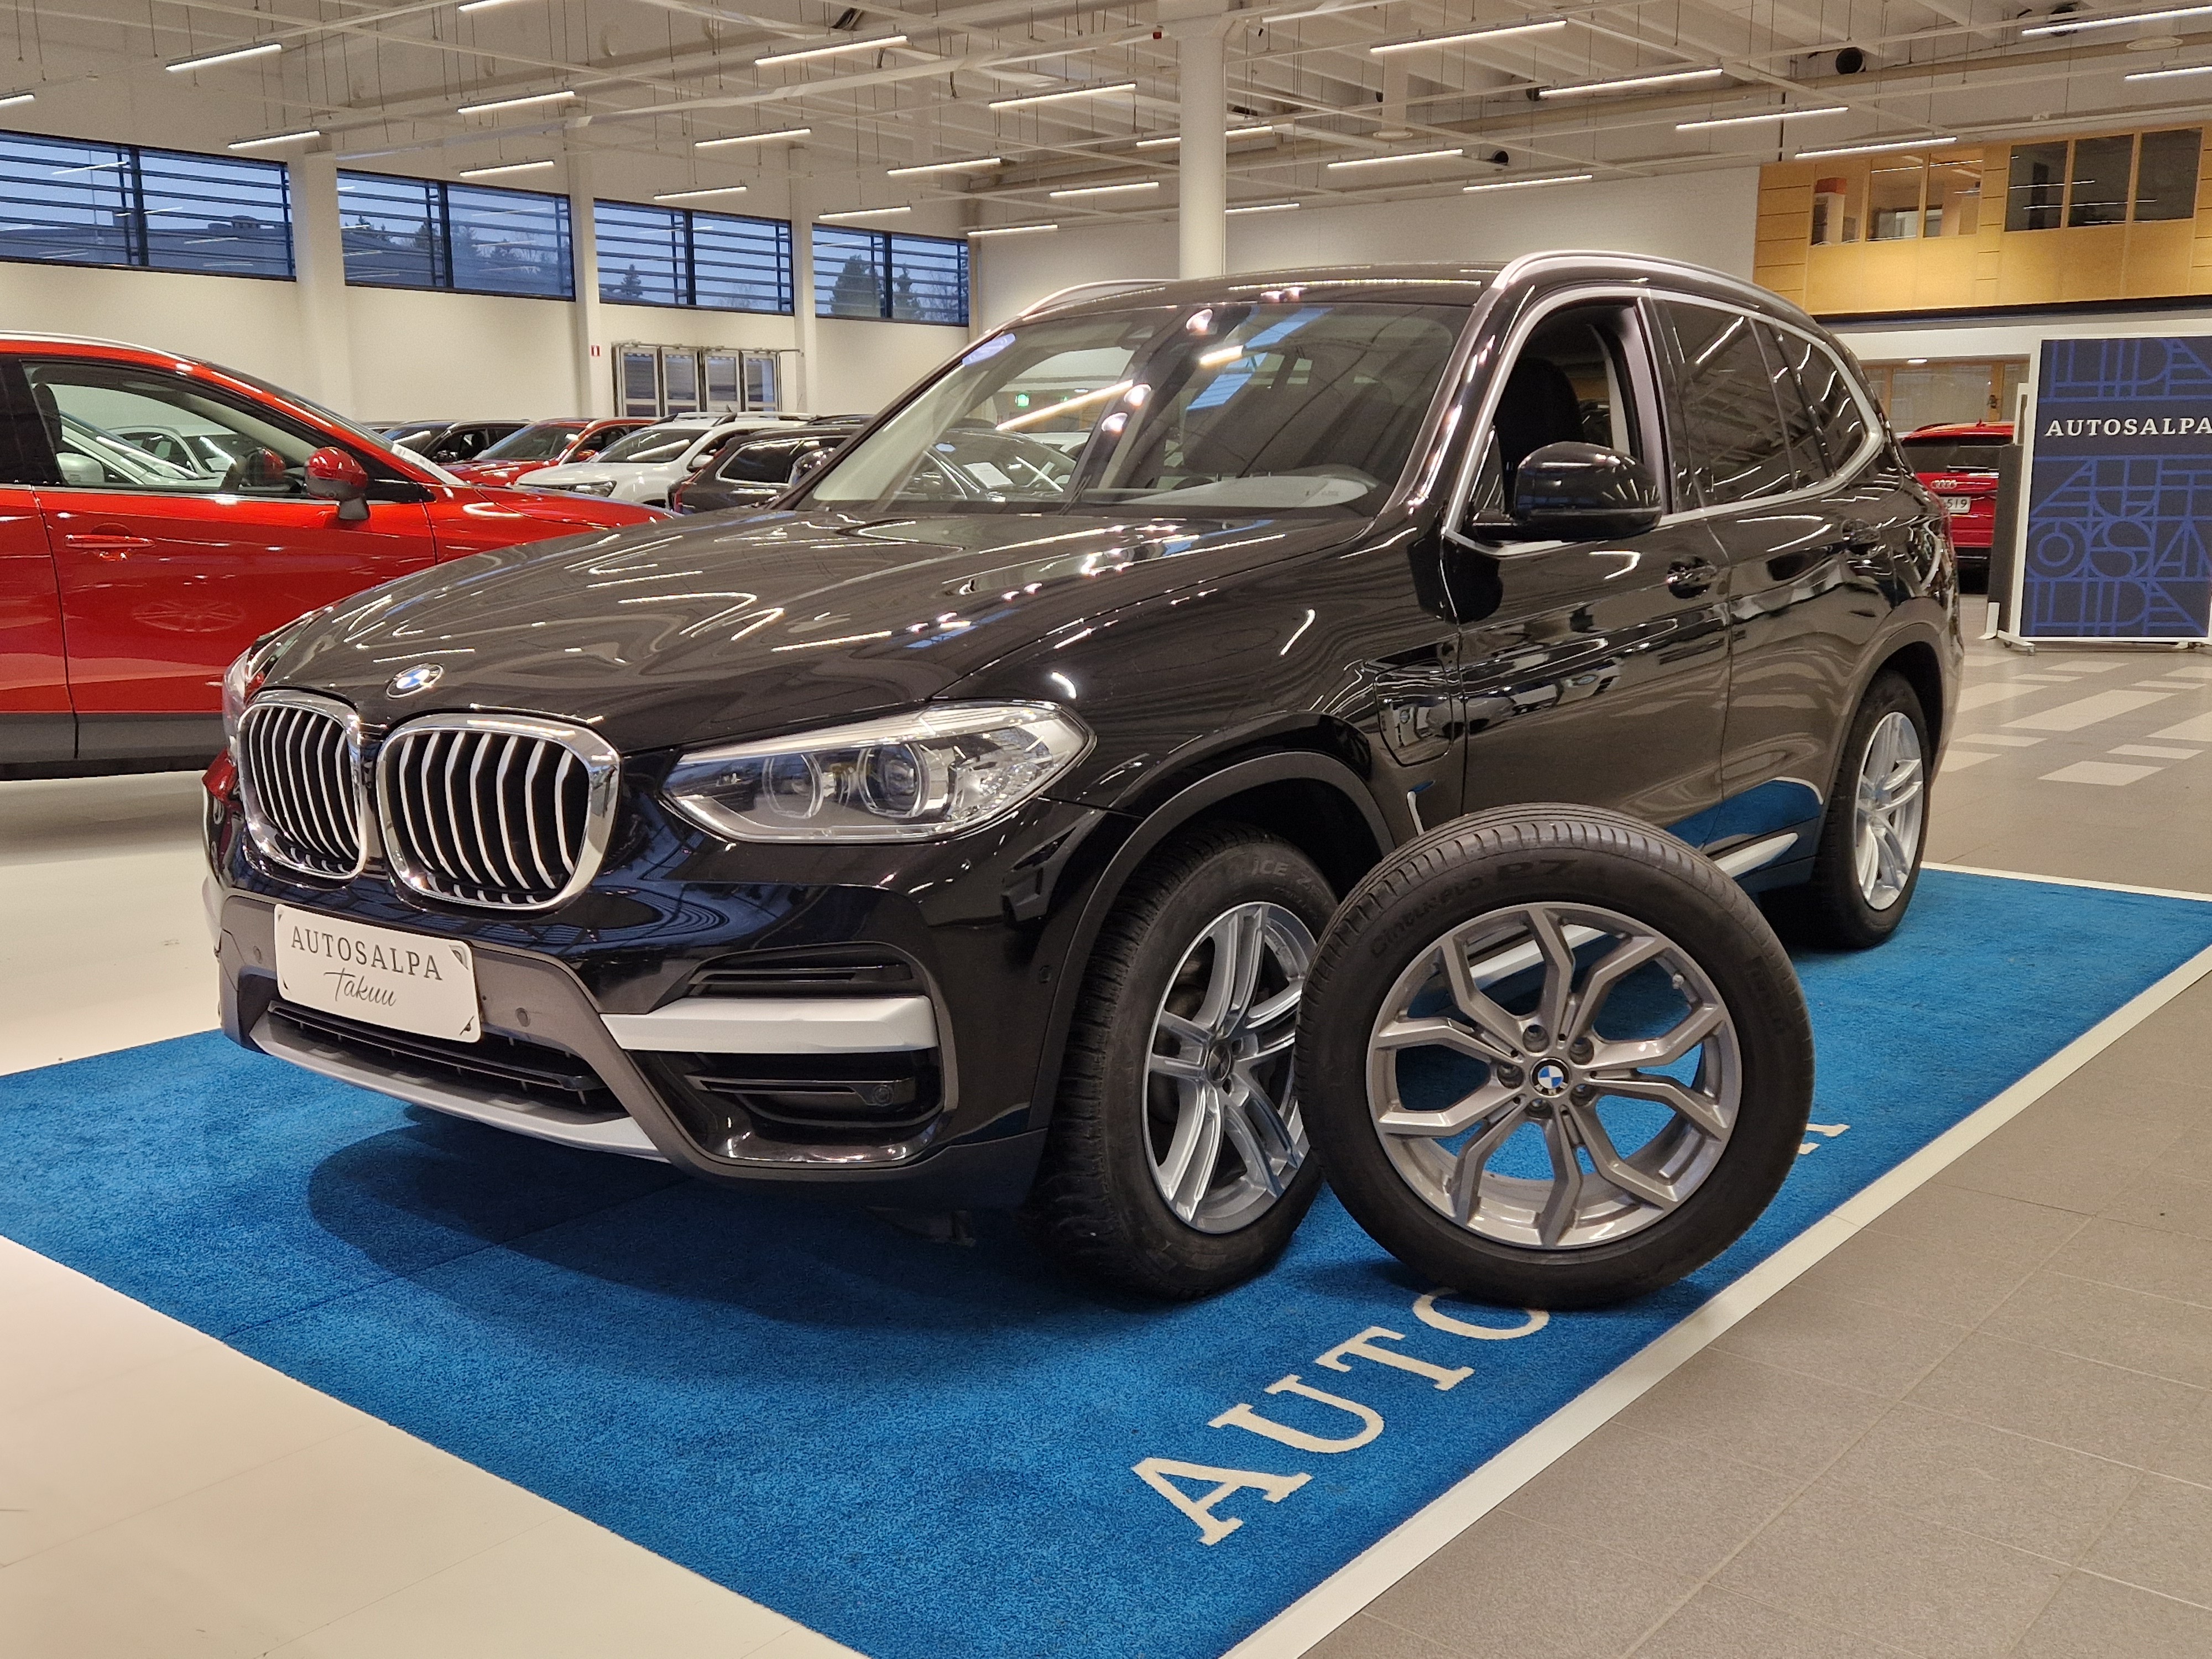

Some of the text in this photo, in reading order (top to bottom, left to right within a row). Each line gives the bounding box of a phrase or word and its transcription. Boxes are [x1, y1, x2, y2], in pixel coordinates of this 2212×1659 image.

[2045, 416, 2212, 437] AUTOSALPA
[291, 926, 443, 981] AUTOSALPA
[324, 968, 397, 1006] Takuu
